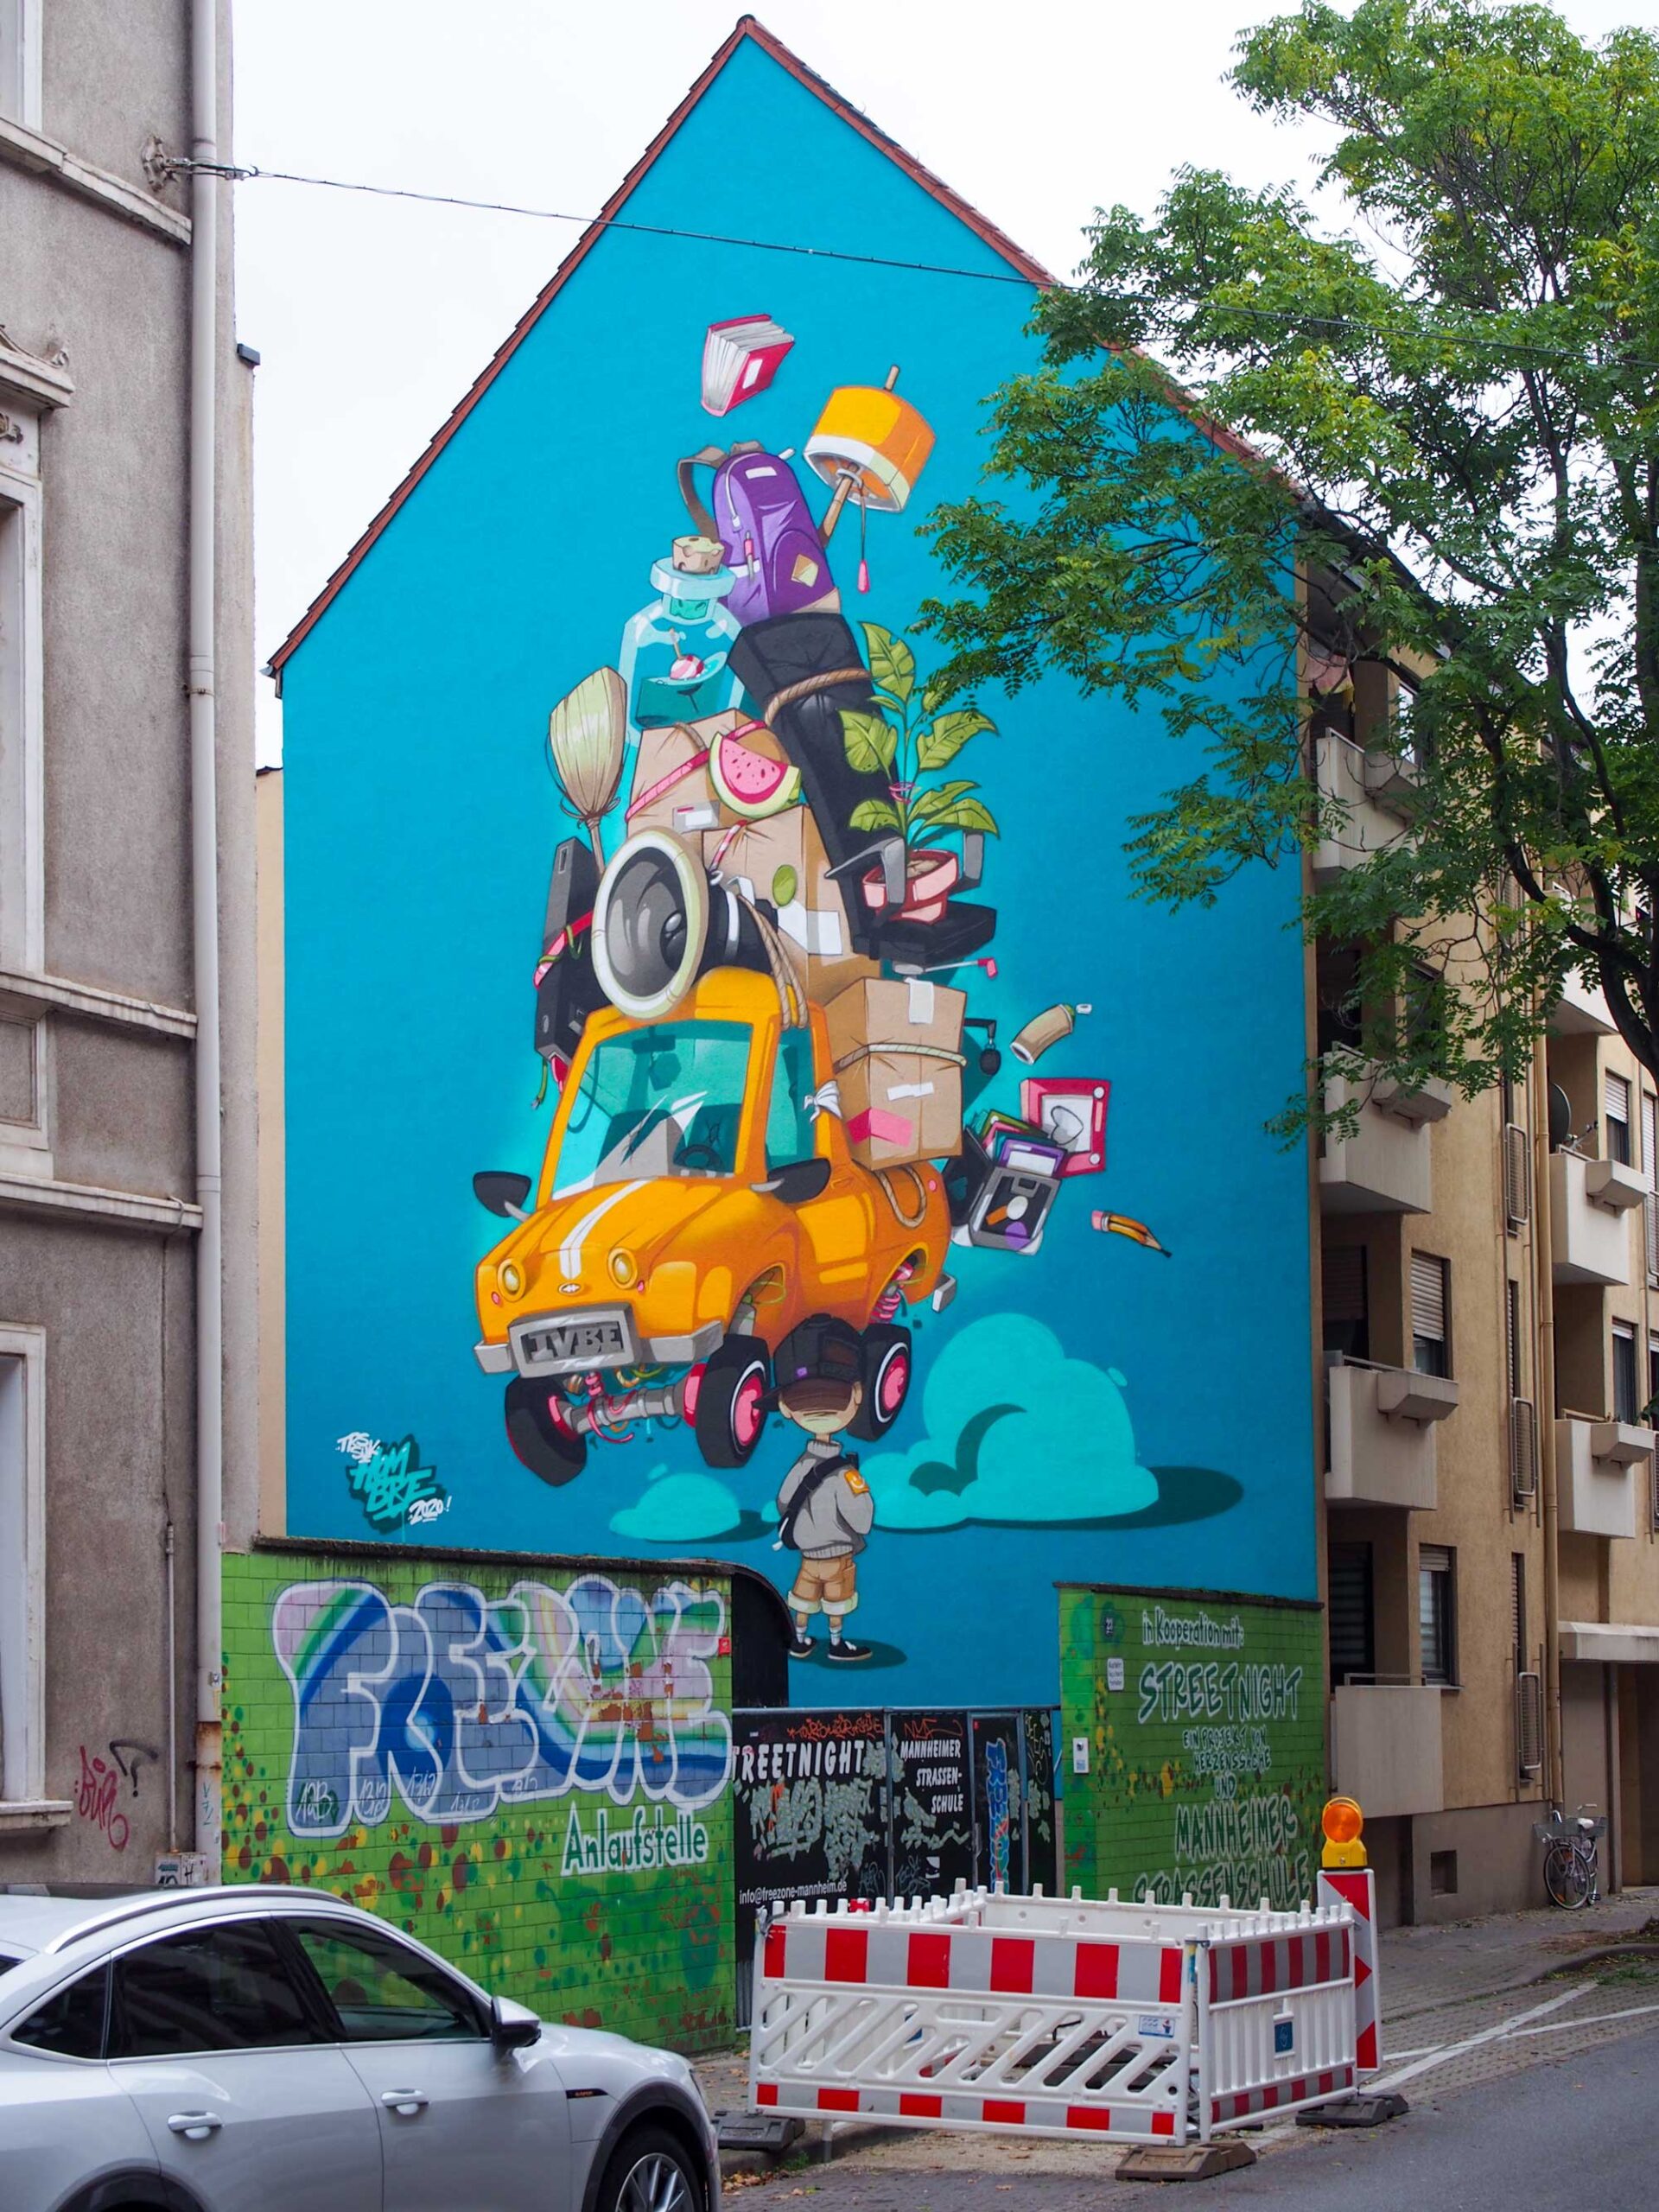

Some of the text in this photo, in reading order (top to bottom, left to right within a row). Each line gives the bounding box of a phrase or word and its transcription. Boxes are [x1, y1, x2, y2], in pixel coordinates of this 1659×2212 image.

[1142, 1610, 1154, 1646] in
[1154, 1605, 1220, 1650] Kooperation
[1138, 1661, 1303, 1725] STREETNIGHT
[900, 1738, 962, 1761] MANNHEIMER
[1182, 1727, 1200, 1750] EIN
[1201, 1725, 1247, 1751] PROJEKT
[732, 1740, 865, 1783] TREETNIGHT
[1194, 1746, 1272, 1774] HERZENSSACHE
[916, 1766, 963, 1788] STRASSEN-
[1214, 1770, 1236, 1800] UND
[931, 1793, 964, 1815] SCHULE
[560, 1800, 709, 1878] Anlaufstelle
[1175, 1793, 1299, 1863] MANNHEIMER
[739, 1878, 848, 1905] info@freezone-mannheim.de
